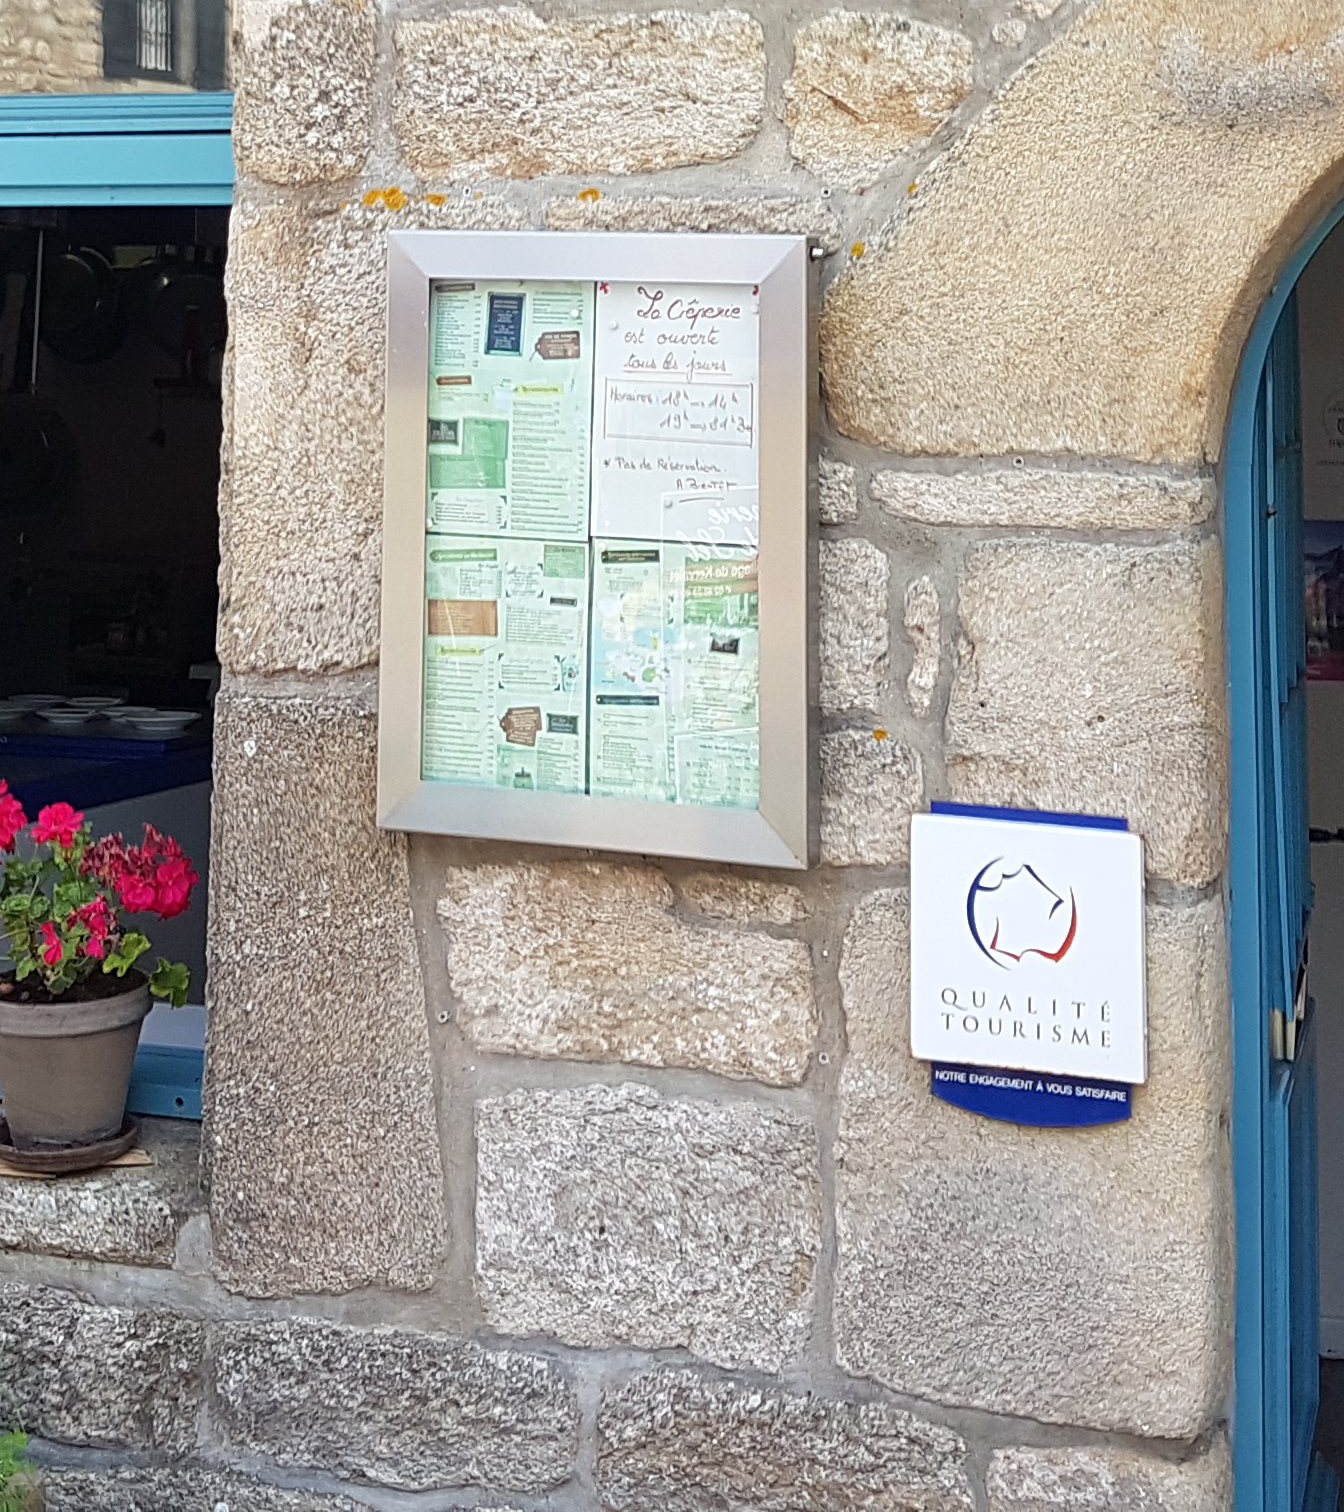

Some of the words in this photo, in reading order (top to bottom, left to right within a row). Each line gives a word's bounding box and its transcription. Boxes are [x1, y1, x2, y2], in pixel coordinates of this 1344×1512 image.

[637, 285, 664, 320] La
[624, 327, 645, 345] est
[656, 325, 720, 345] ouverte
[623, 353, 657, 370] tous
[662, 351, 679, 370] les
[685, 349, 727, 383] jours
[639, 457, 653, 470] de
[940, 987, 1111, 1024] QUALITÉ
[940, 1011, 1111, 1049] TOURISME
[935, 1070, 967, 1084] NOTRE
[969, 1073, 1034, 1092] ENGAGEMENT
[1046, 1081, 1073, 1097] VOUS
[1075, 1085, 1127, 1103] SATISFAIRE
